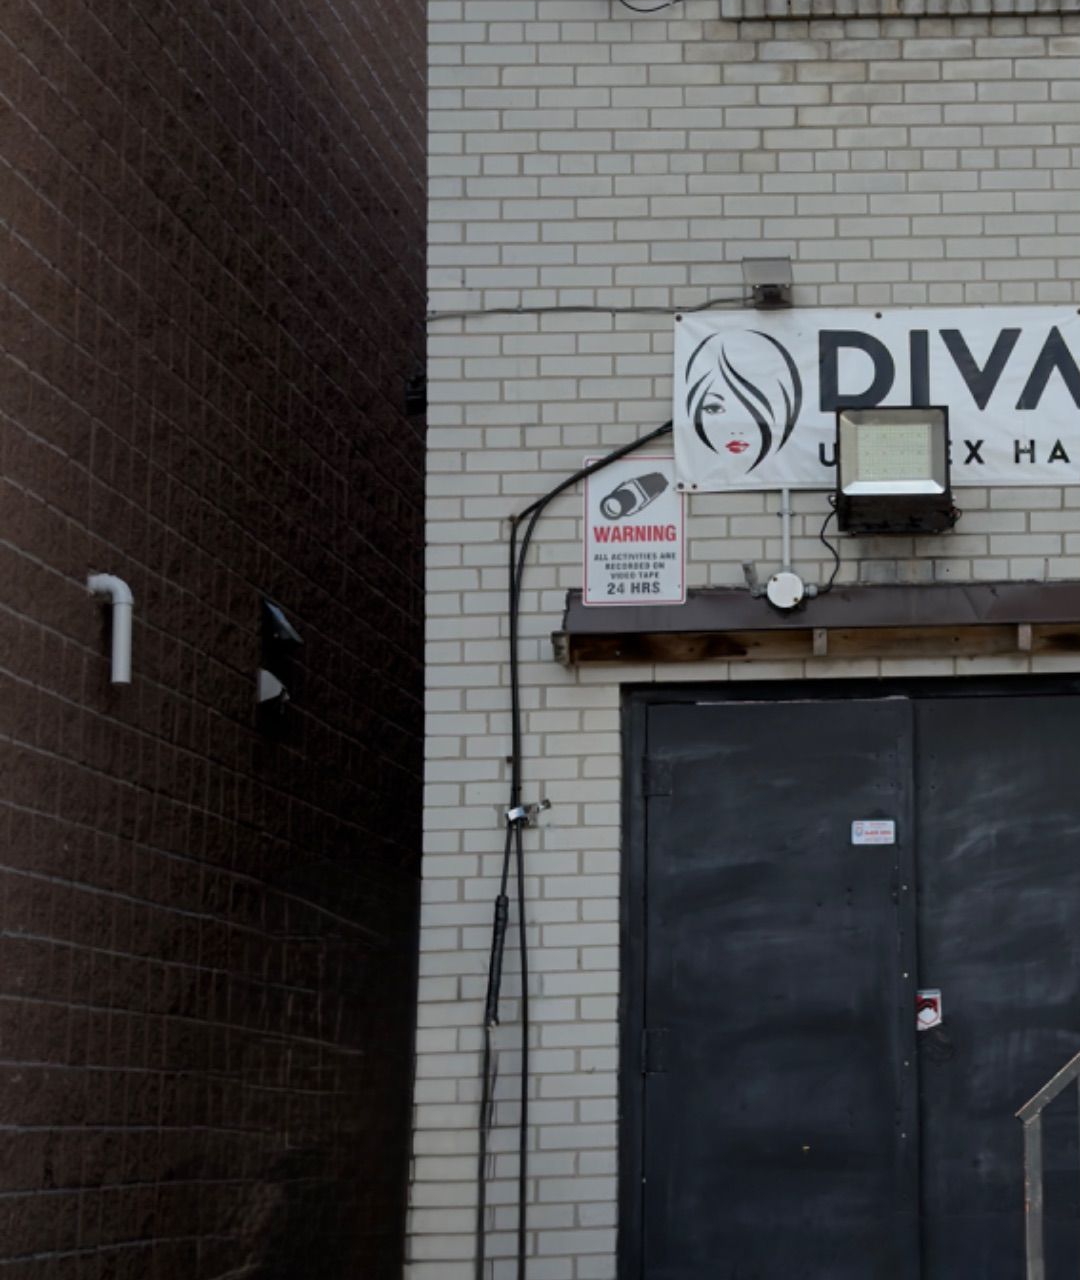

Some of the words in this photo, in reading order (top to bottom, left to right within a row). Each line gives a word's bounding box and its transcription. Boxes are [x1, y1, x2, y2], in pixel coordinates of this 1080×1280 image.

[593, 525, 677, 544] WARNING
[611, 552, 657, 560] ACTIVITIES
[605, 562, 650, 570] RECORDED
[610, 572, 636, 580] VIDEO
[638, 571, 659, 579] TAPE
[607, 582, 625, 595] 24
[630, 581, 661, 594] HRS
